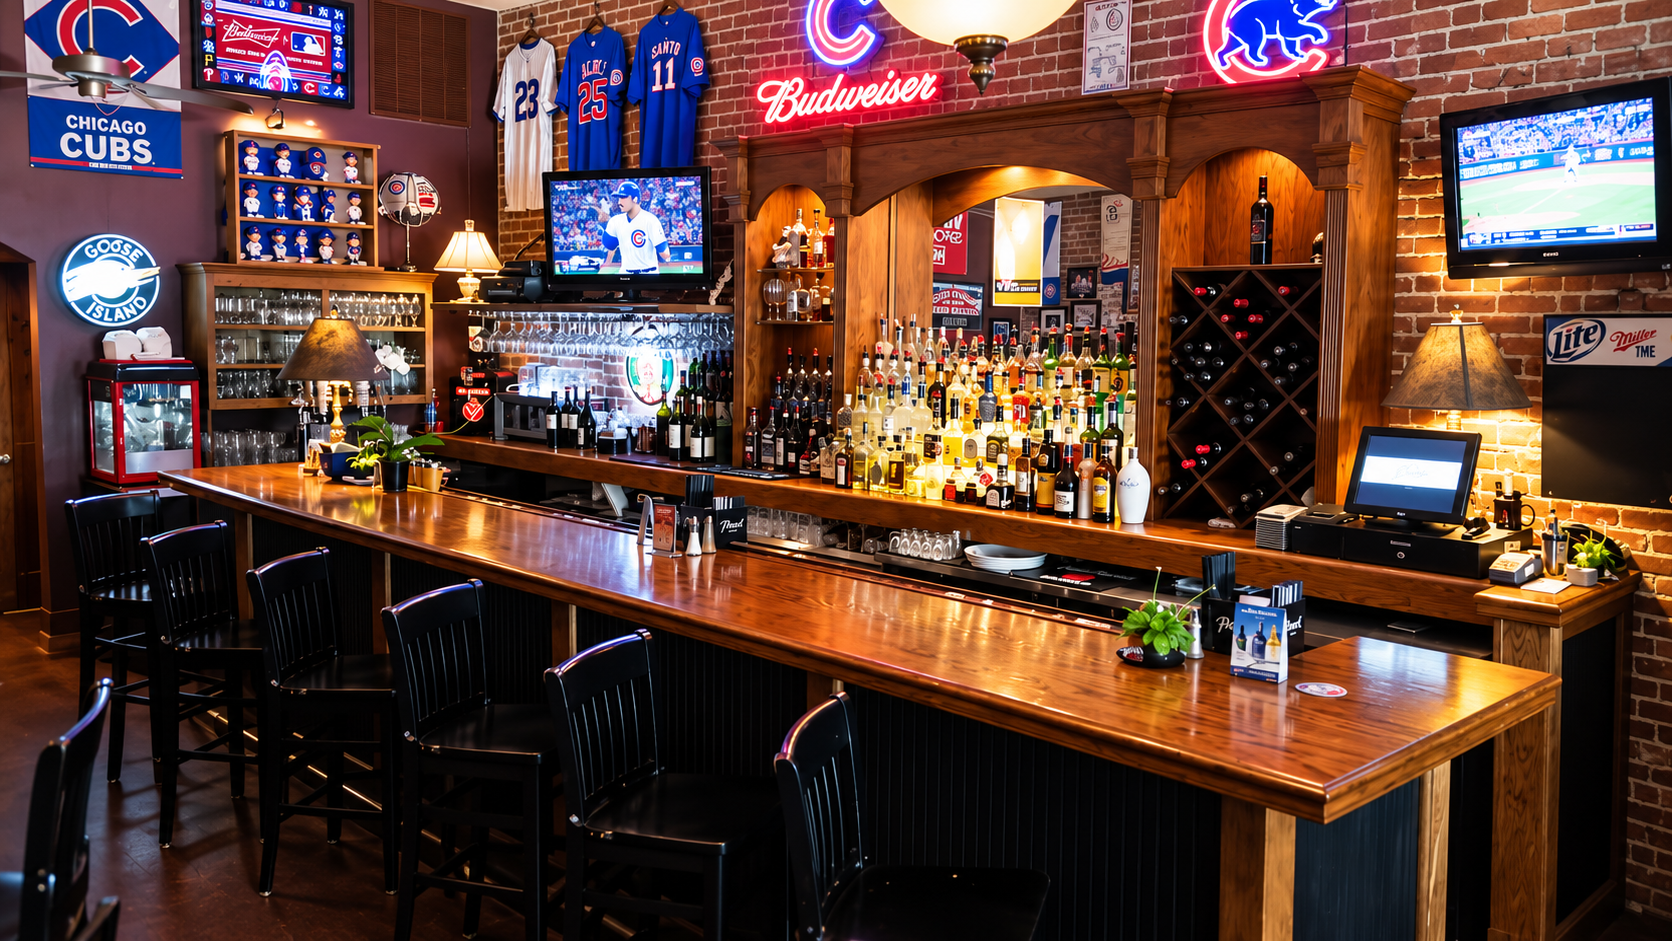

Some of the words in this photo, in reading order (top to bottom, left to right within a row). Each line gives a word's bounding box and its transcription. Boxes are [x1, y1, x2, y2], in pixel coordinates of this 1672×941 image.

[651, 40, 681, 60] SANTO
[651, 57, 676, 92] 11
[515, 78, 540, 122] 23
[577, 77, 609, 124] 25
[756, 69, 938, 124] Budweiser
[65, 114, 147, 135] CHICAGO
[59, 131, 153, 164] CUBS
[84, 239, 144, 262] GOOSE
[86, 296, 147, 321] ISLAND
[1552, 324, 1598, 359] Lite
[1609, 329, 1657, 350] Miller
[1635, 345, 1656, 358] TME
